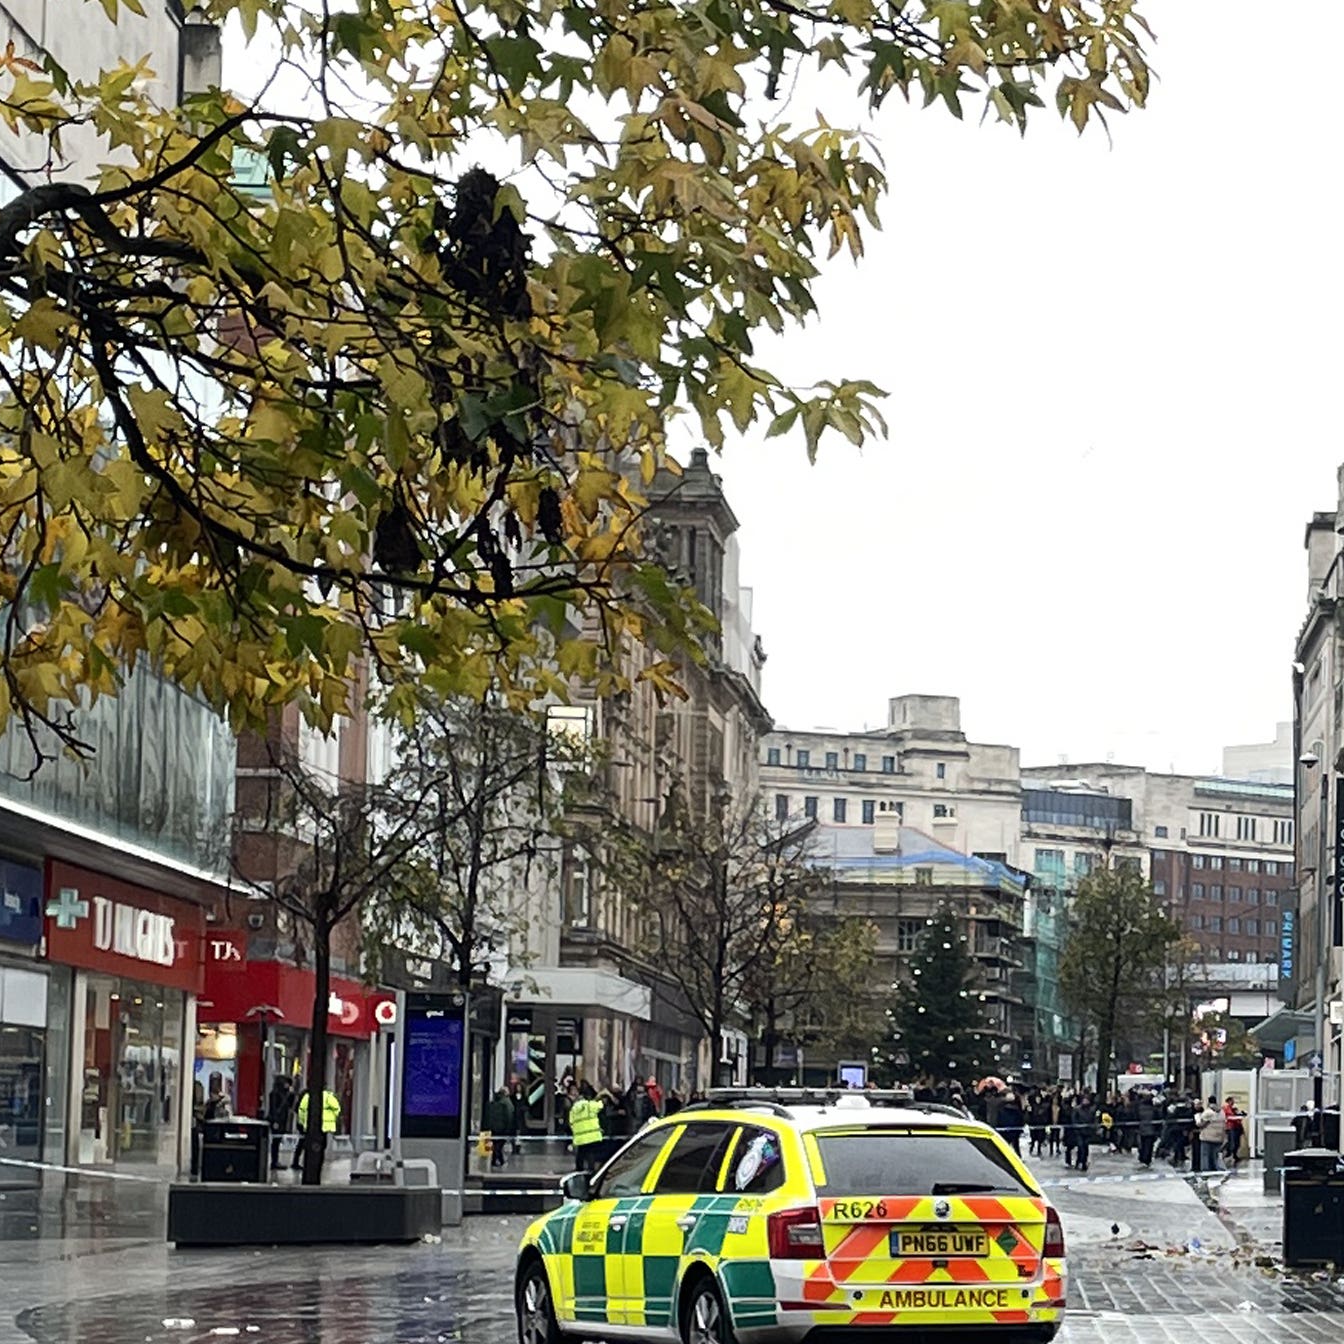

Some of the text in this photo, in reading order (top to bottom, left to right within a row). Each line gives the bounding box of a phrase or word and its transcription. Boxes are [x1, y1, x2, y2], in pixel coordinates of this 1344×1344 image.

[833, 1200, 889, 1220] R626
[901, 1235, 986, 1252] PN66 UWF
[879, 1289, 1009, 1309] AMBULANCE
